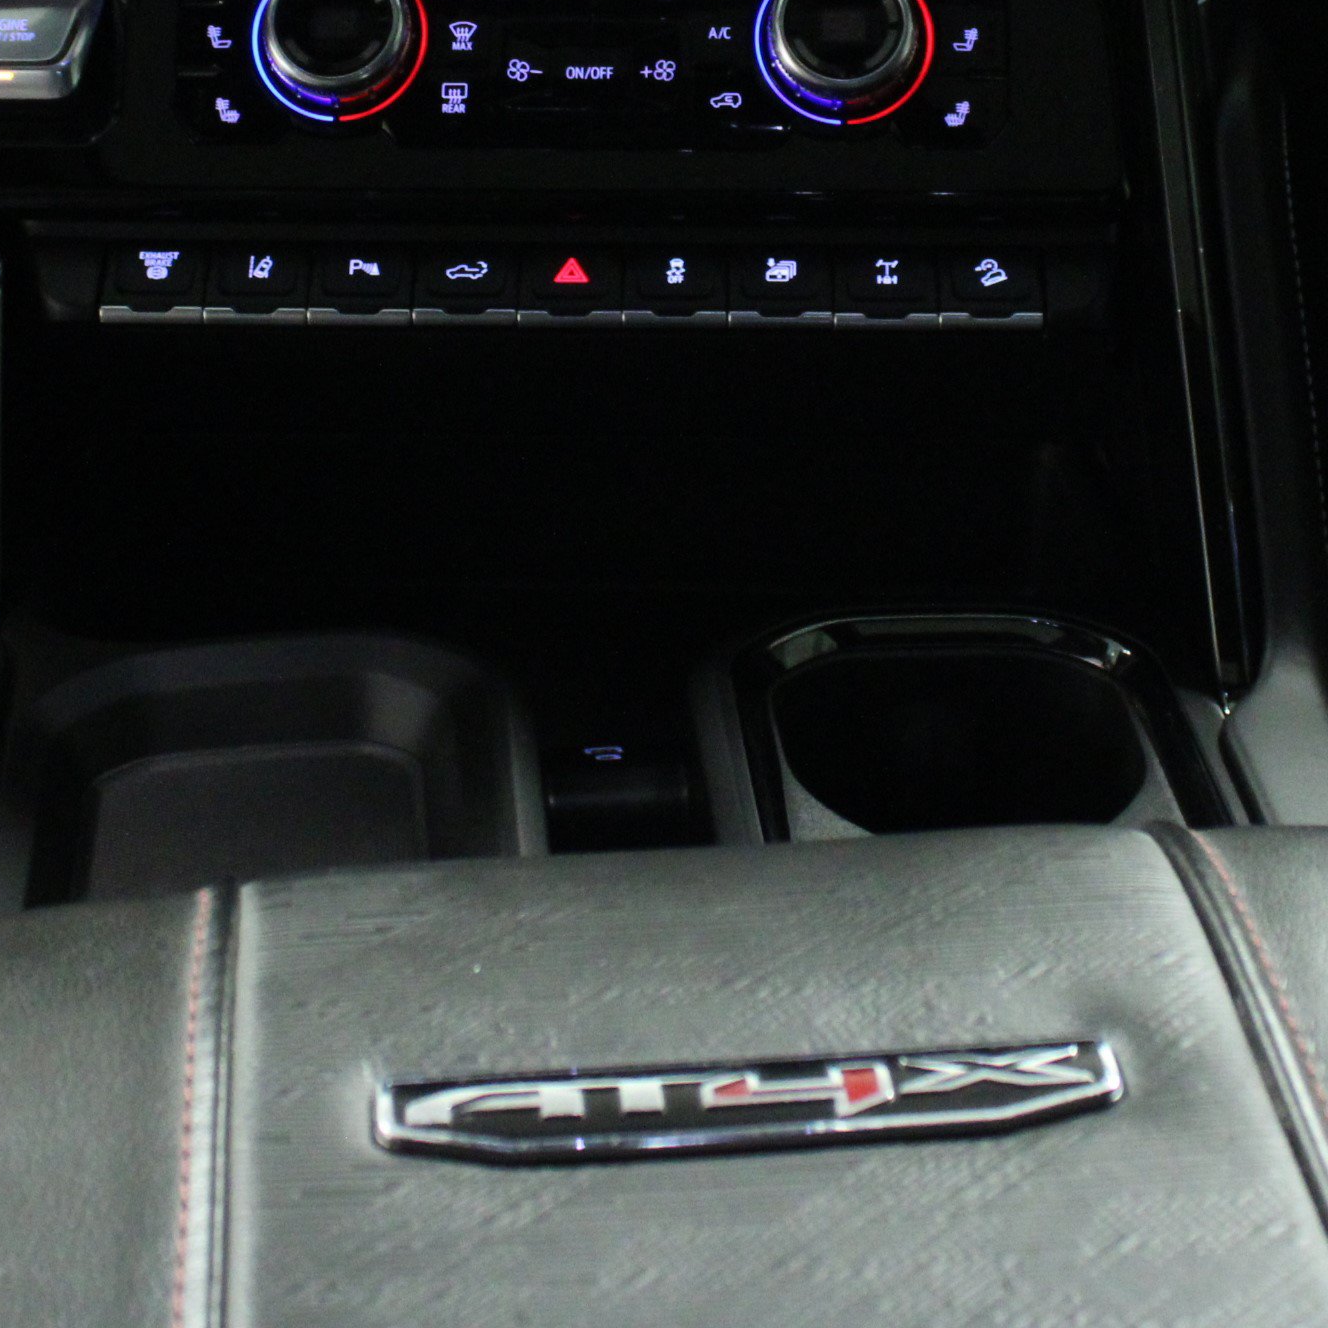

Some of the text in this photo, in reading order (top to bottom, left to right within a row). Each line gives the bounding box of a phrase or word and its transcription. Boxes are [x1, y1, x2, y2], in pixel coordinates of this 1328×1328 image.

[708, 26, 732, 40] A/C
[451, 41, 473, 51] MAX
[565, 66, 614, 80] ON/OFF
[441, 103, 466, 114] REAR
[139, 251, 180, 260] EXHAUST
[144, 259, 174, 267] BRAKE
[667, 274, 685, 284] OFF
[404, 1045, 1097, 1125] AT4X
